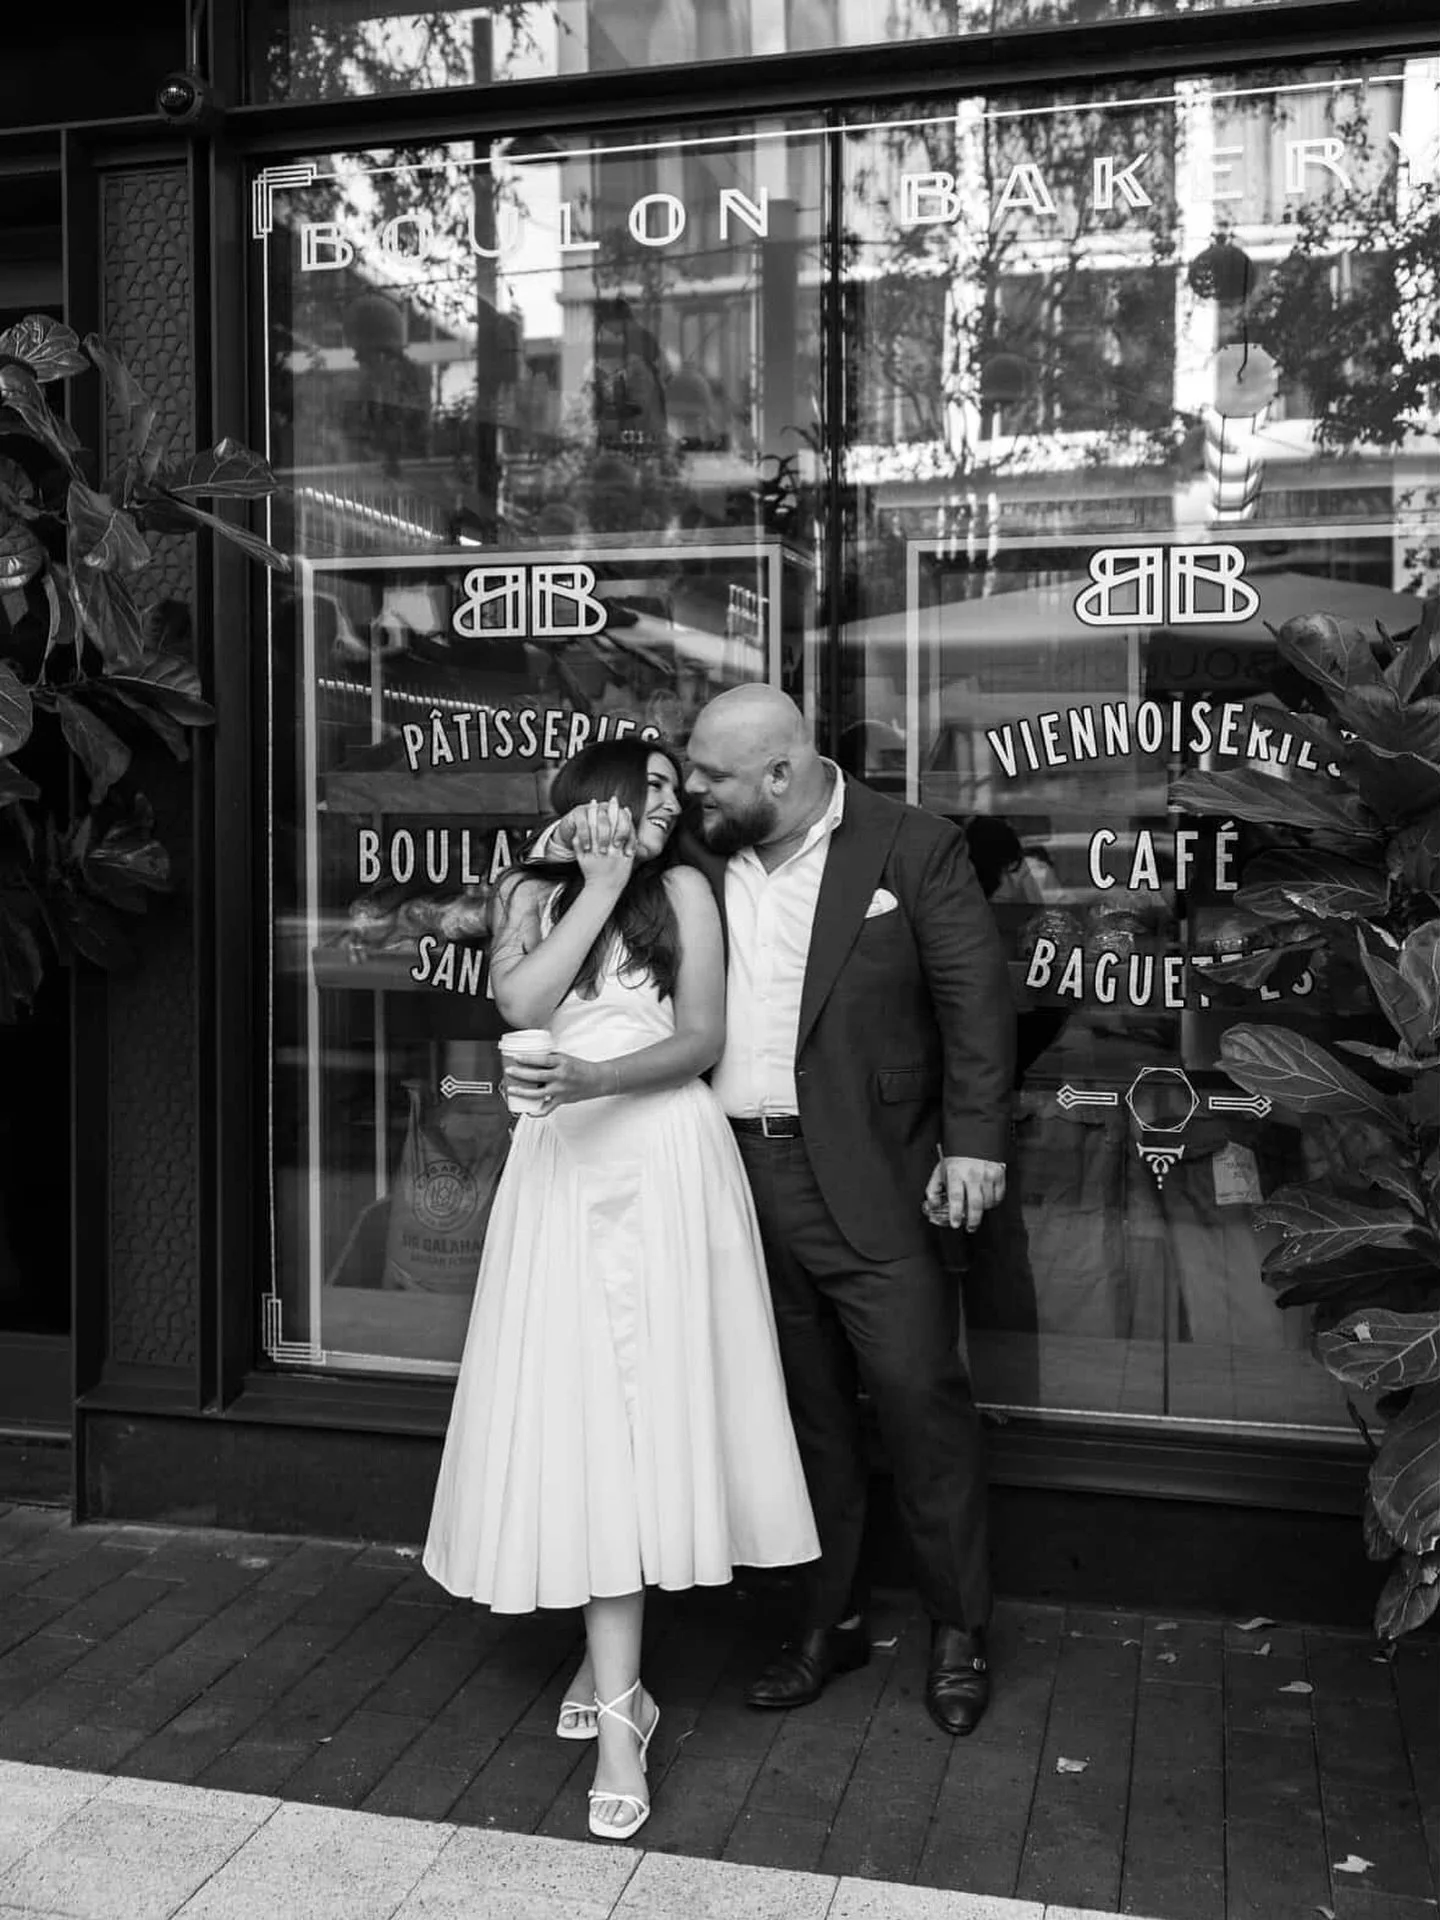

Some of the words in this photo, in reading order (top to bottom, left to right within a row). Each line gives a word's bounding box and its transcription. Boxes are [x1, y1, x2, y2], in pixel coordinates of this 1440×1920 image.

[301, 186, 769, 272] BOULON
[900, 130, 1438, 226] BAKER
[986, 700, 1341, 778] VIENNOISERI
[359, 829, 533, 884] BOULA
[1089, 820, 1239, 891] CAFÉ
[411, 936, 495, 1000] SAN
[1025, 937, 1313, 1009] BAGUET
